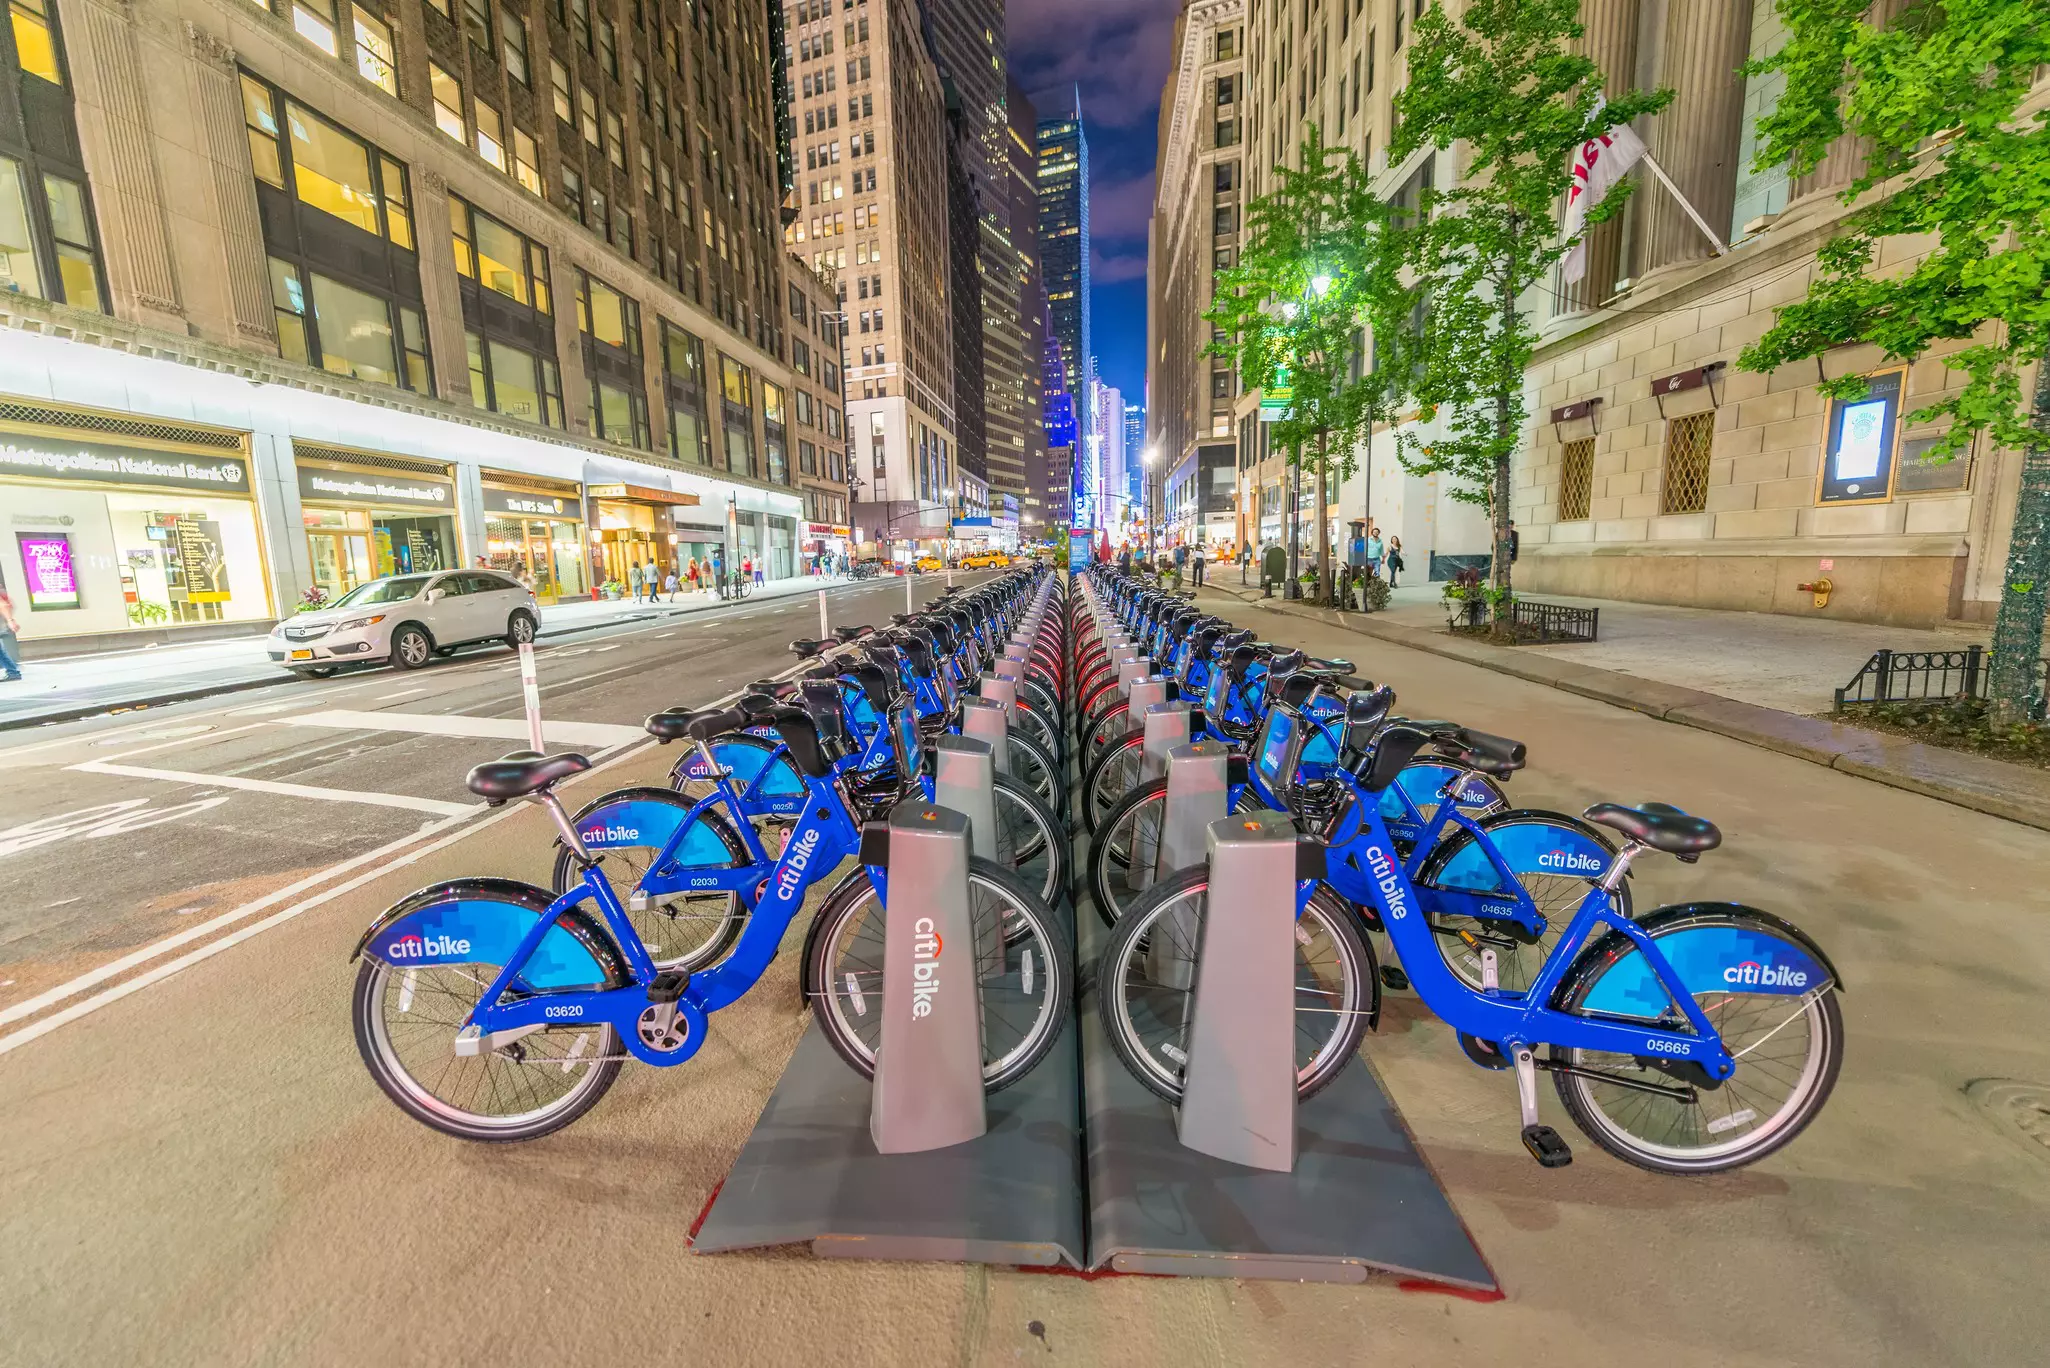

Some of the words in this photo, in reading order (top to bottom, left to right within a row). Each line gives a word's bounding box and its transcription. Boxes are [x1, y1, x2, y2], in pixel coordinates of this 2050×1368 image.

[0, 445, 118, 471] Metropolitan
[119, 457, 186, 478] National
[187, 464, 223, 481] Bank
[507, 499, 522, 511] The
[772, 802, 794, 811] 00250
[1389, 828, 1414, 839] 05950
[690, 877, 718, 887] 02030
[1481, 904, 1513, 917] 04635
[545, 1005, 584, 1018] 03620
[1646, 1039, 1691, 1056] 05665
